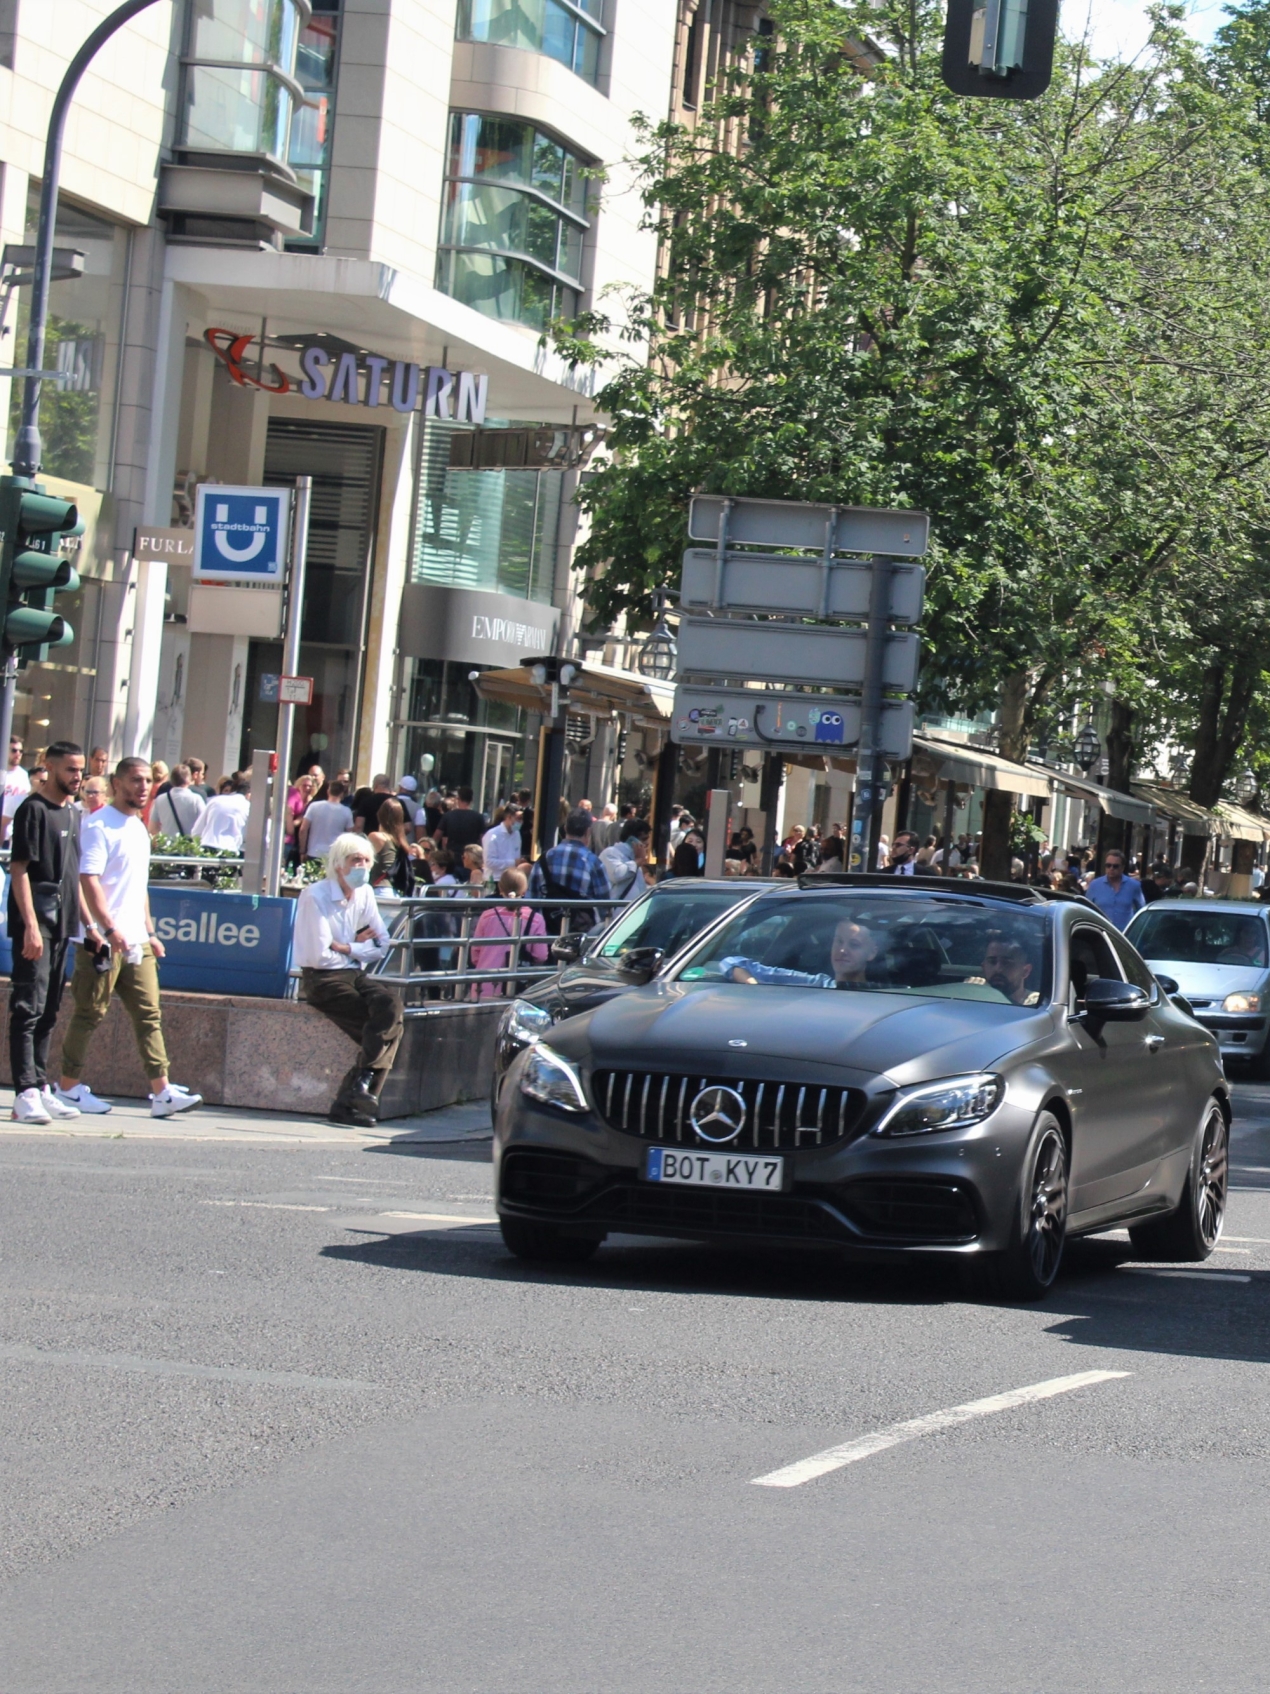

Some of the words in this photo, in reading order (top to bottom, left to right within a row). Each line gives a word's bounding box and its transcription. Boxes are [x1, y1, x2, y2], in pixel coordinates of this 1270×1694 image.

[301, 347, 489, 424] SATURN
[211, 523, 271, 533] stadtbahn
[139, 536, 194, 555] FURL
[663, 1154, 710, 1181] BOT
